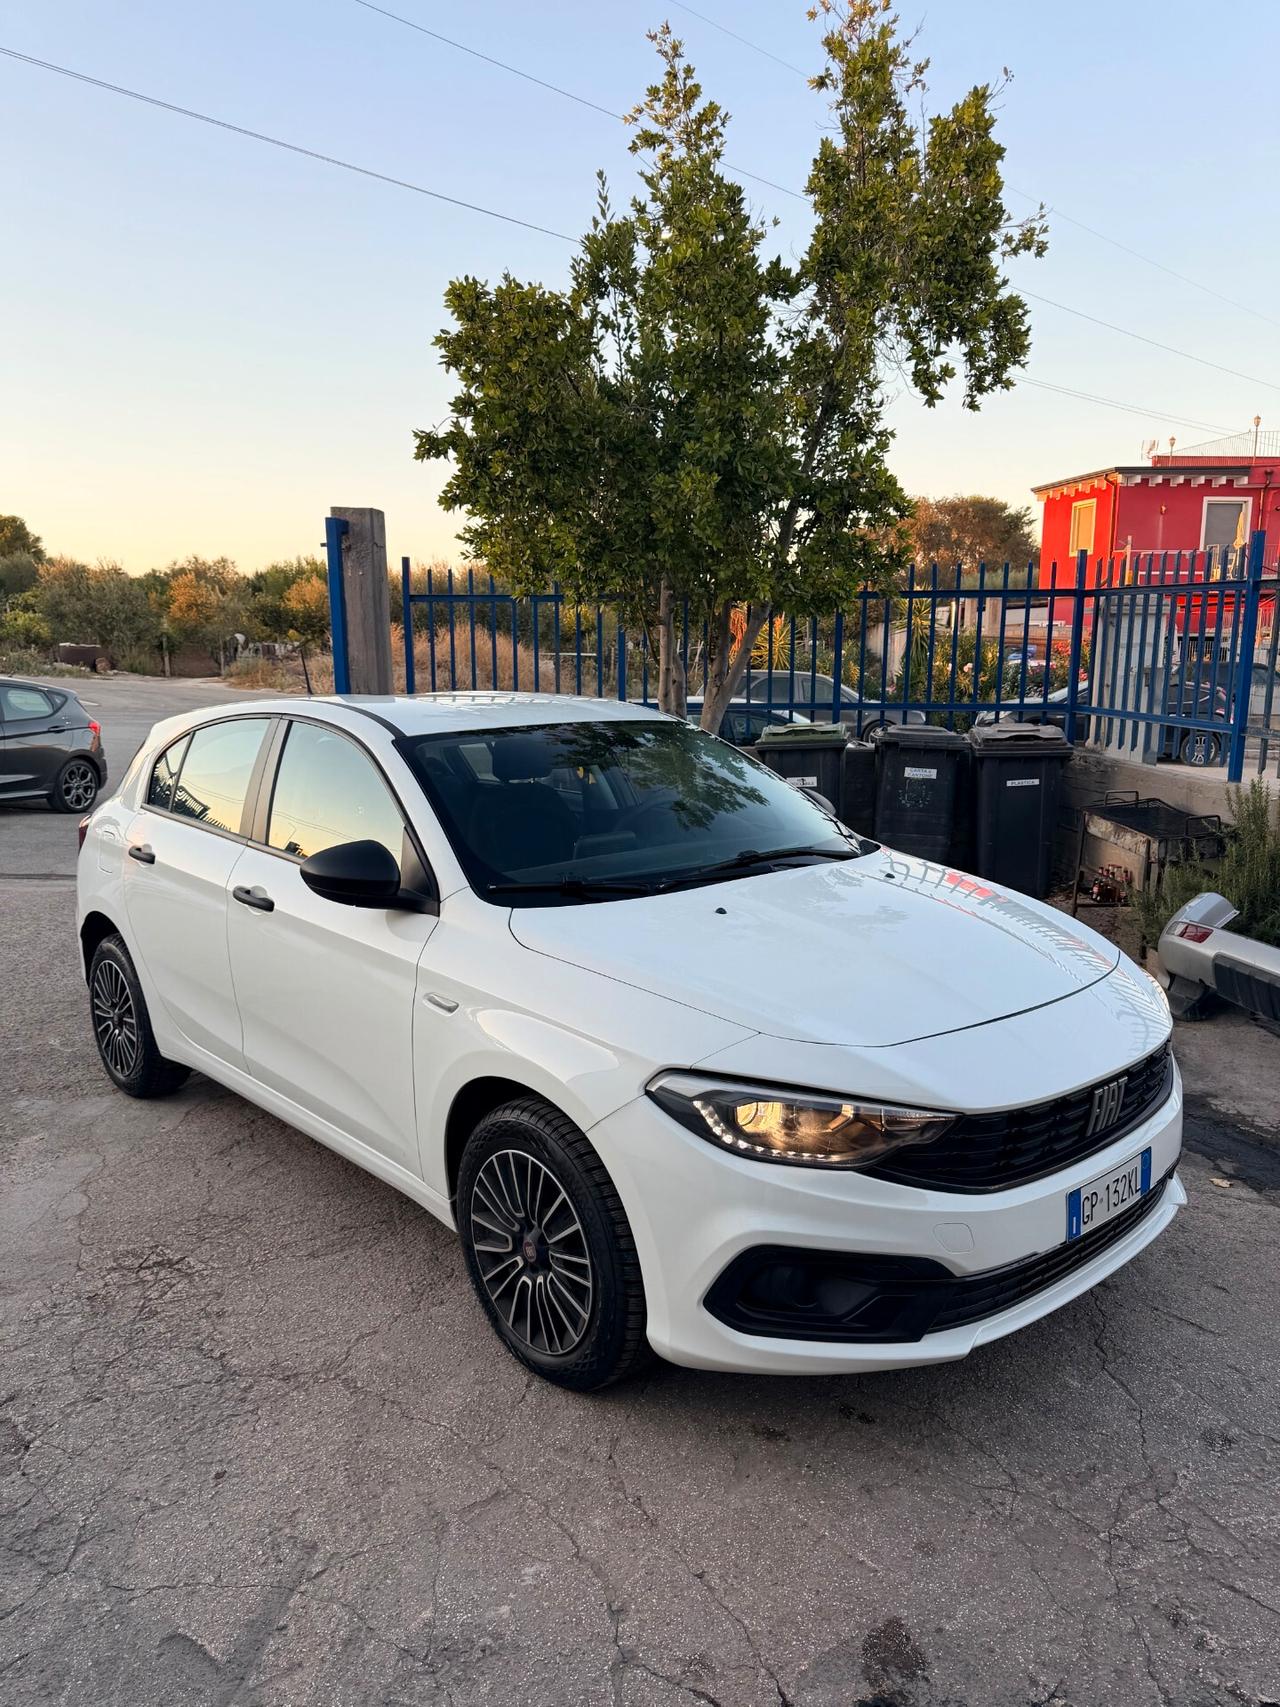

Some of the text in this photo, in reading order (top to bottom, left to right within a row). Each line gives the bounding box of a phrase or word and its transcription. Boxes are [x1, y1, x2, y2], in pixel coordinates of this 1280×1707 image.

[1086, 1076, 1128, 1136] FIAT
[1082, 1166, 1141, 1225] GP 132KL
